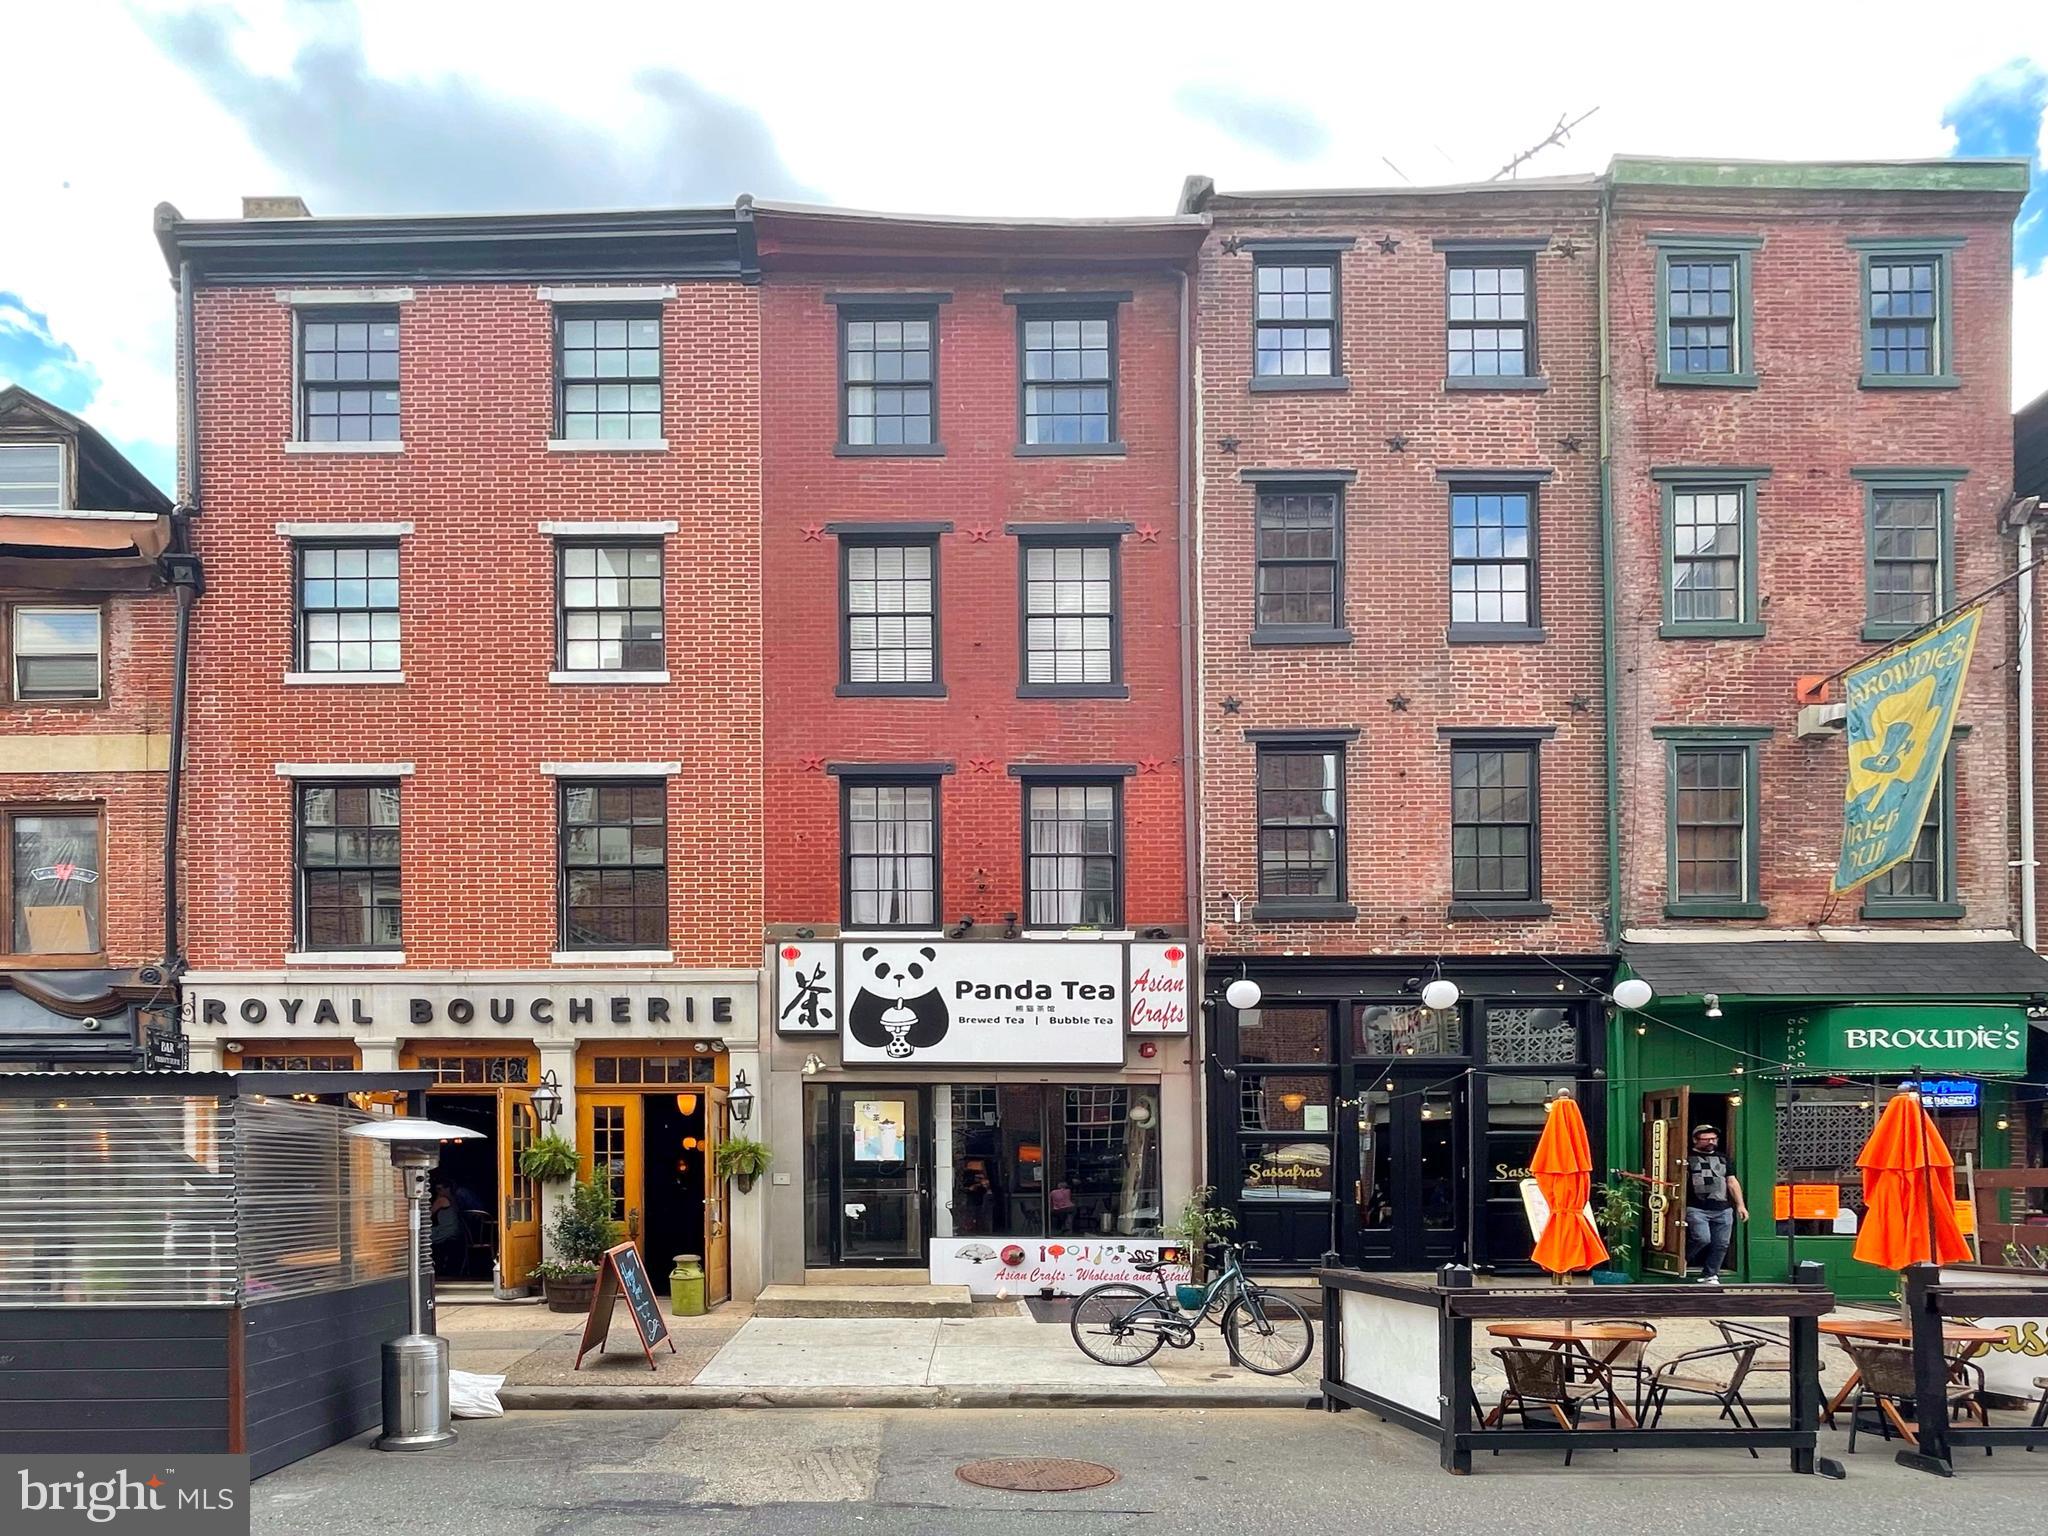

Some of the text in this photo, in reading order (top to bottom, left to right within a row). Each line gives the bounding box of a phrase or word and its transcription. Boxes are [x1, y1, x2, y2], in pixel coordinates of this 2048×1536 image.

[955, 979, 1116, 1000] Panda Tea
[1131, 968, 1185, 993] Asian
[202, 996, 733, 1025] ROYAL BOUCHERIE
[1131, 997, 1185, 1030] Crafts
[958, 1016, 1000, 1025] Brewed
[1004, 1016, 1025, 1025] Tea
[1049, 1016, 1091, 1025] Bubble
[1093, 1016, 1114, 1025] Tea
[1249, 1163, 1323, 1180] Sassafras
[1495, 1163, 1536, 1180] Sass
[994, 1267, 1028, 1281] Asian
[1029, 1267, 1066, 1285] Crafts
[1076, 1267, 1130, 1281] Wholesale
[1132, 1268, 1153, 1281] and
